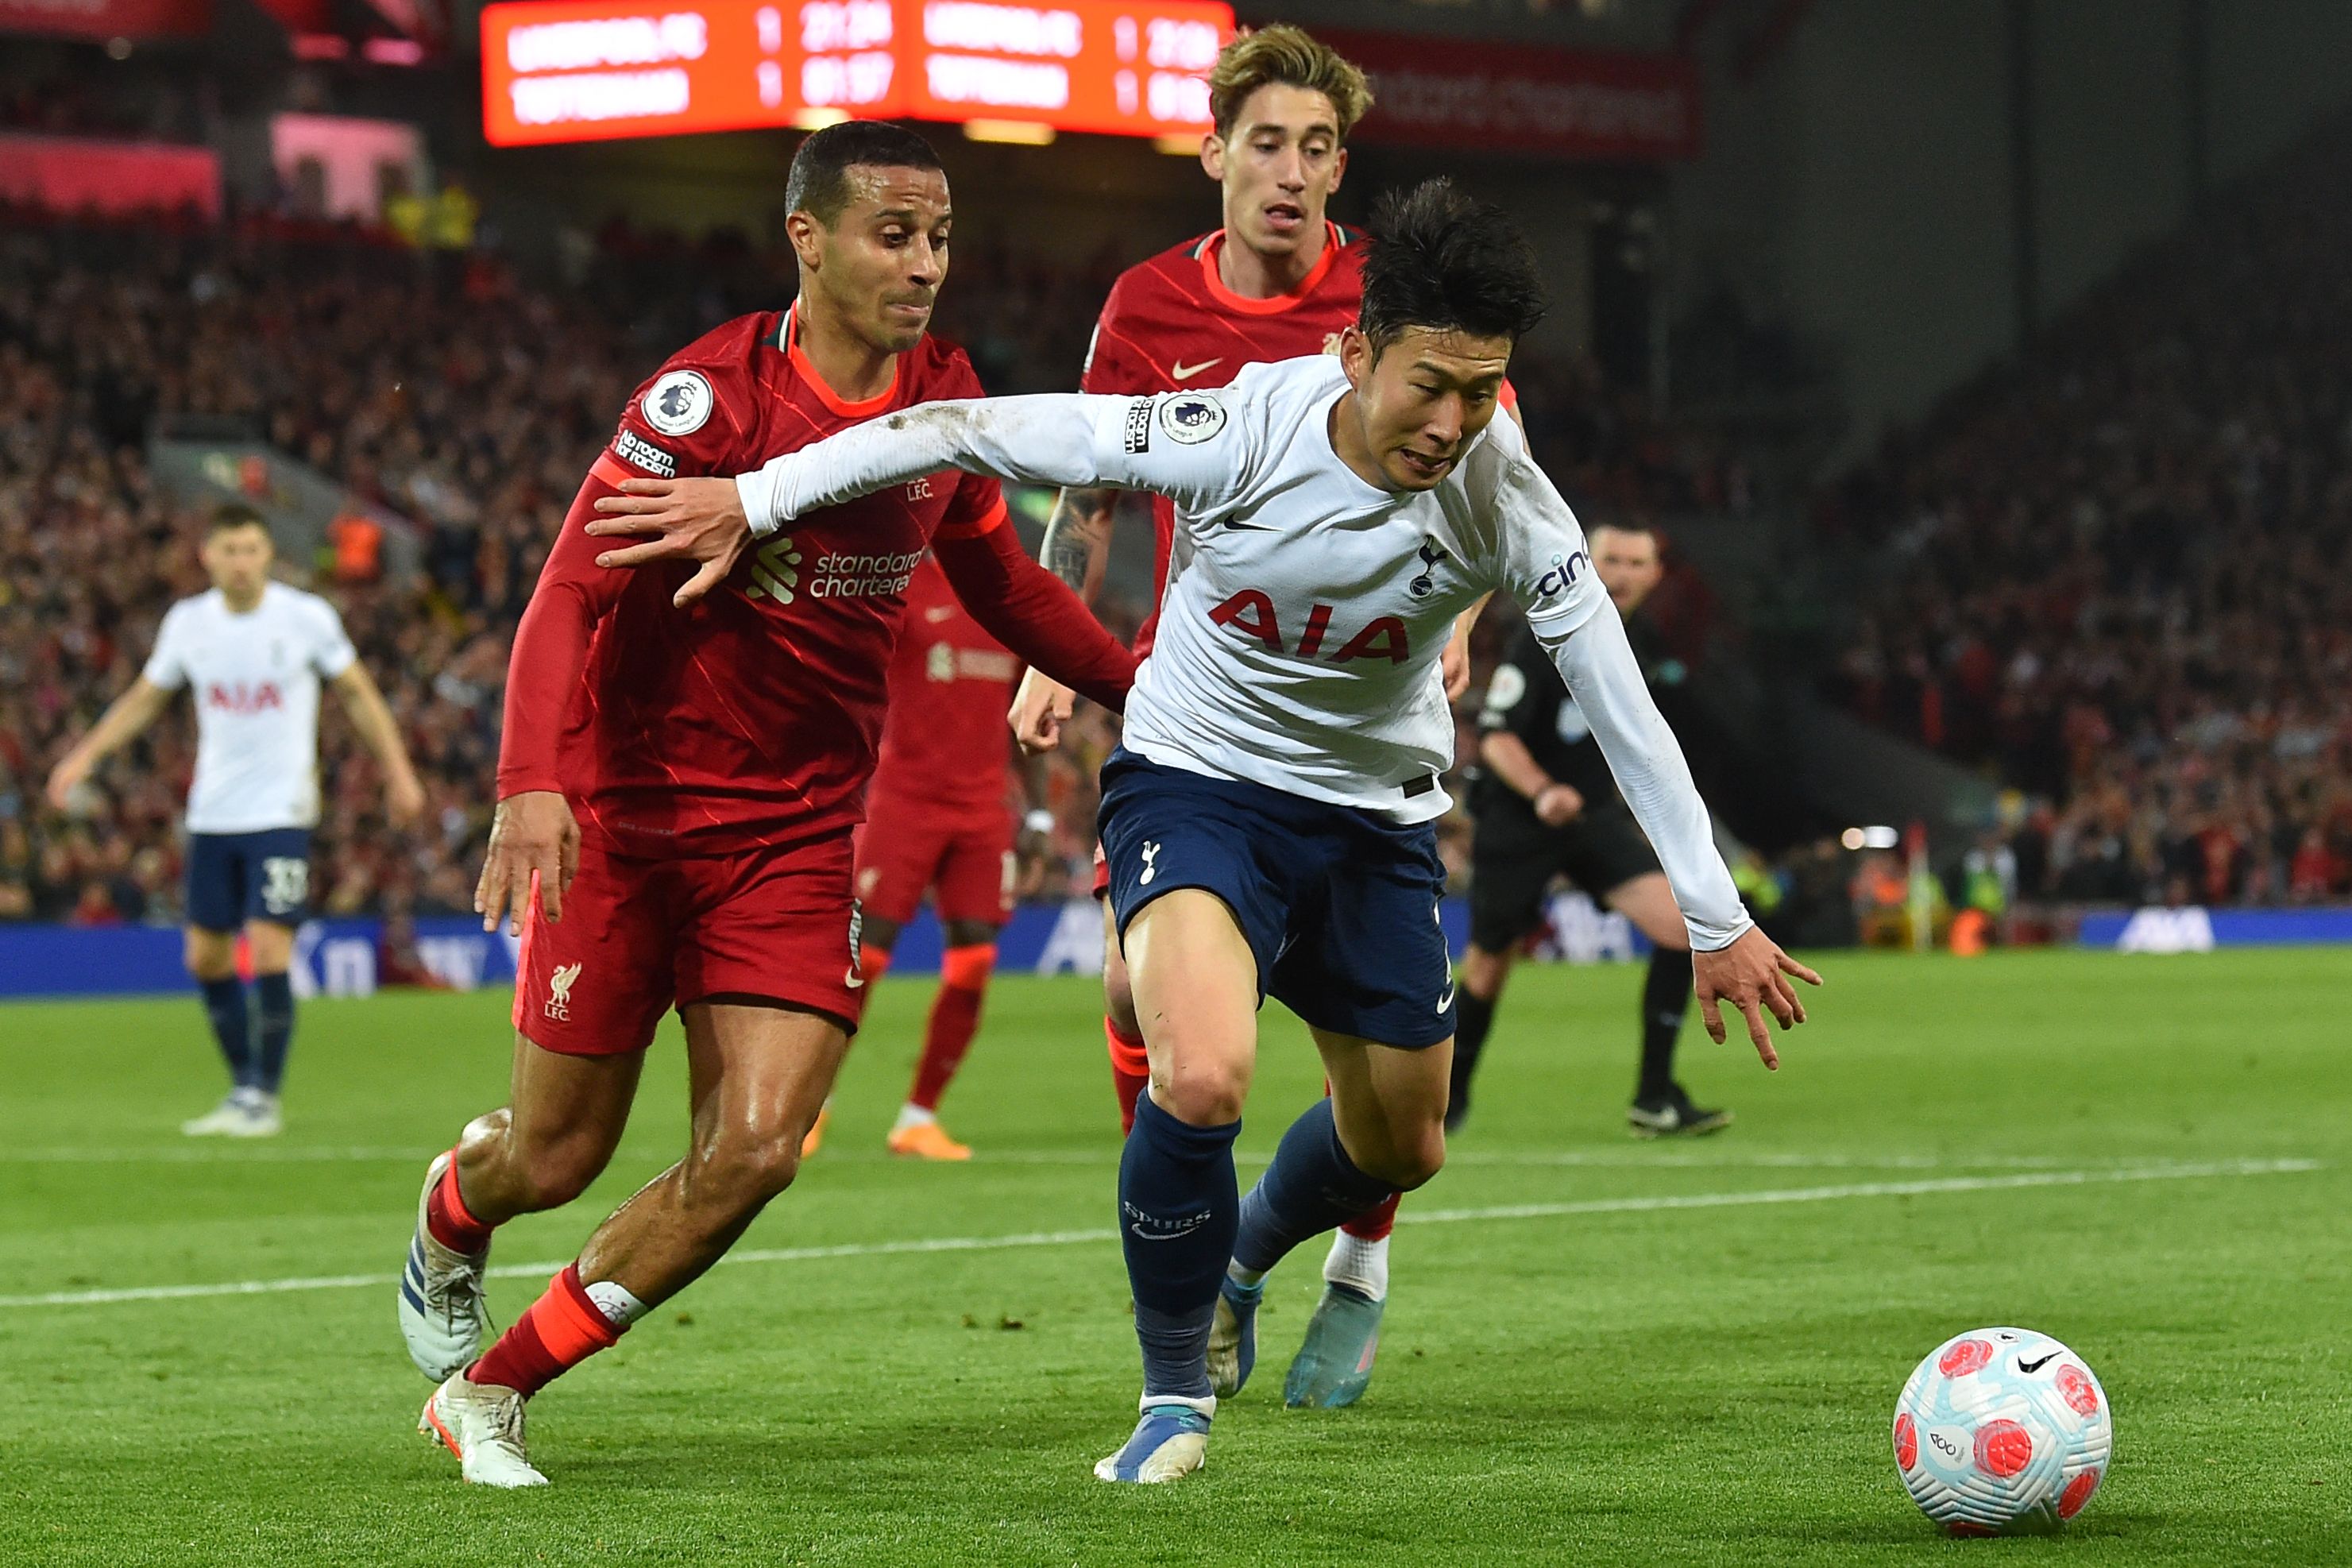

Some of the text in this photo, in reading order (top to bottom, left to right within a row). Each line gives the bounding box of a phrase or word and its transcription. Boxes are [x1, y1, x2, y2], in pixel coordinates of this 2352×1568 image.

[1136, 408, 1150, 446] room
[628, 450, 676, 478] racism
[635, 440, 674, 467] room
[1207, 589, 1411, 666] AIA
[1124, 1200, 1211, 1230] SPURS
